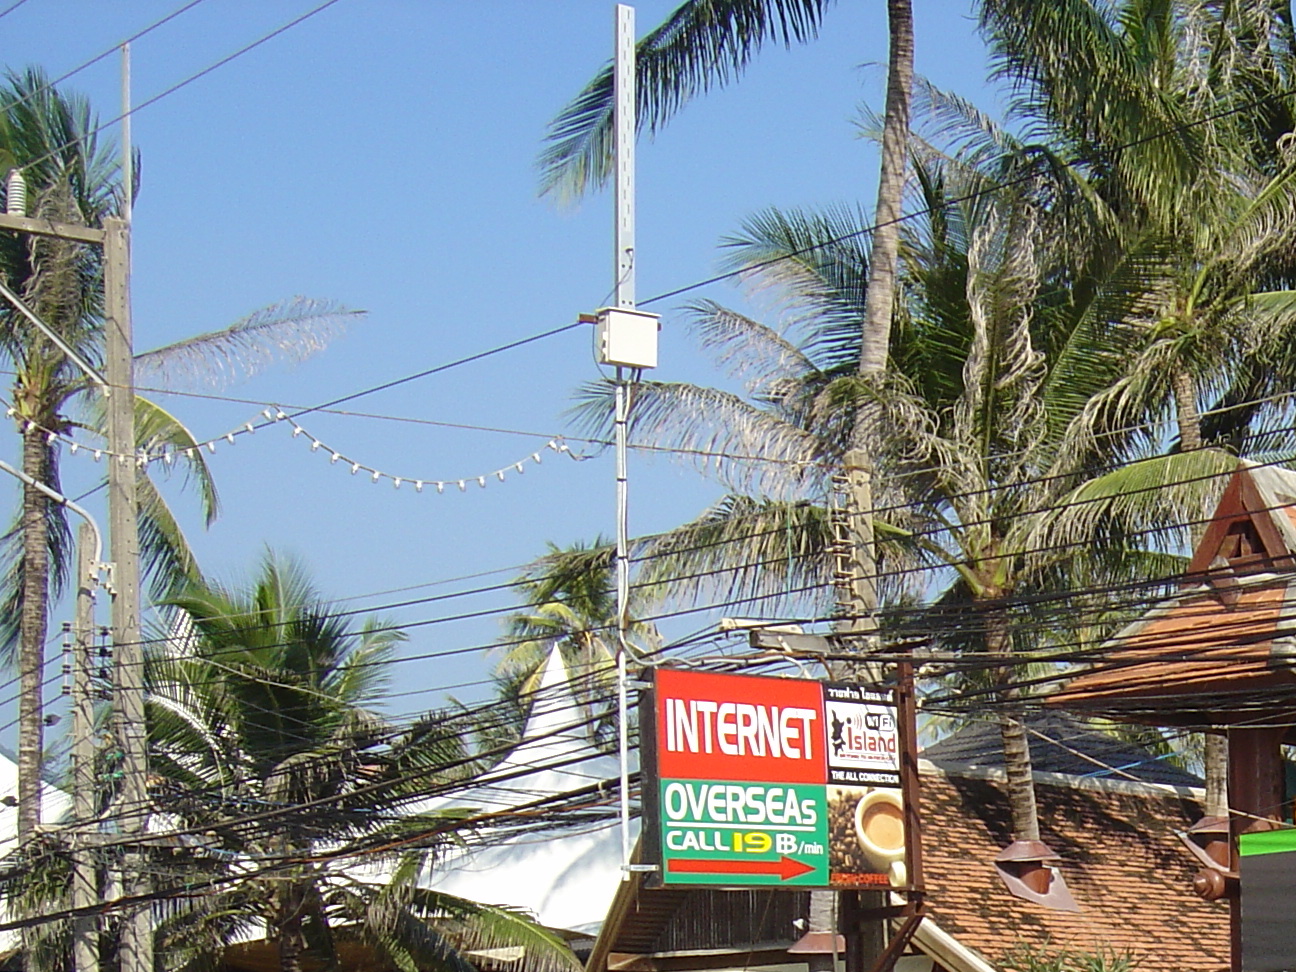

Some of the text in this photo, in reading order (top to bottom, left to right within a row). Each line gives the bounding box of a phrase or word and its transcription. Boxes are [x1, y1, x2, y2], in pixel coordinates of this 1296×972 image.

[666, 698, 817, 760] INTERNET
[847, 726, 896, 753] Island
[664, 782, 817, 825] OVERSEAS
[666, 830, 730, 851] CALL
[733, 832, 773, 853] 19
